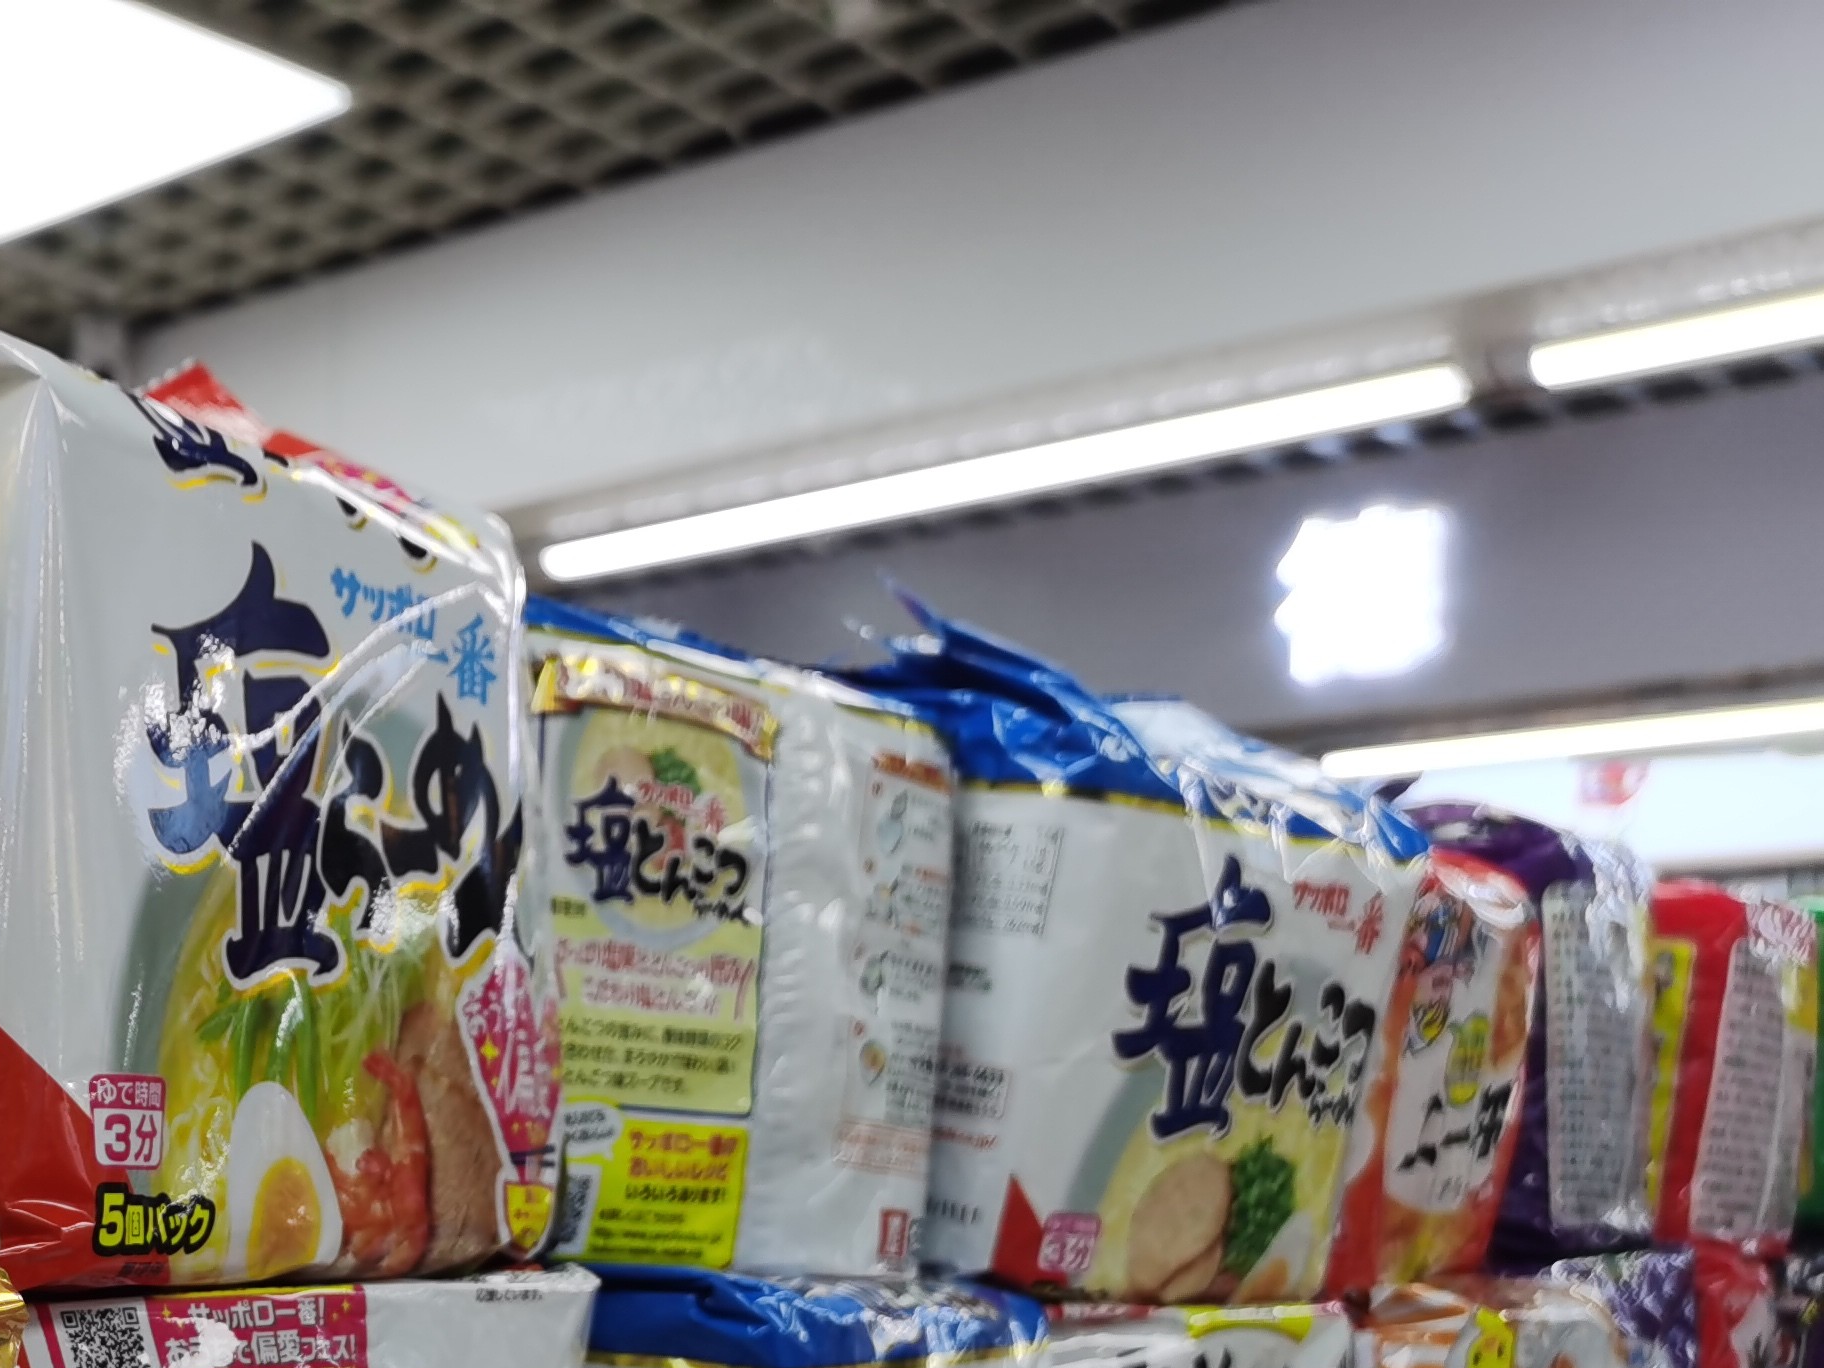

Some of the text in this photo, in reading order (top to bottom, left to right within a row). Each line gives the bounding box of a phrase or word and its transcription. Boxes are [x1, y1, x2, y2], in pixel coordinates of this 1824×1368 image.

[103, 1113, 158, 1163] 3分
[98, 1191, 212, 1247] 5個パック
